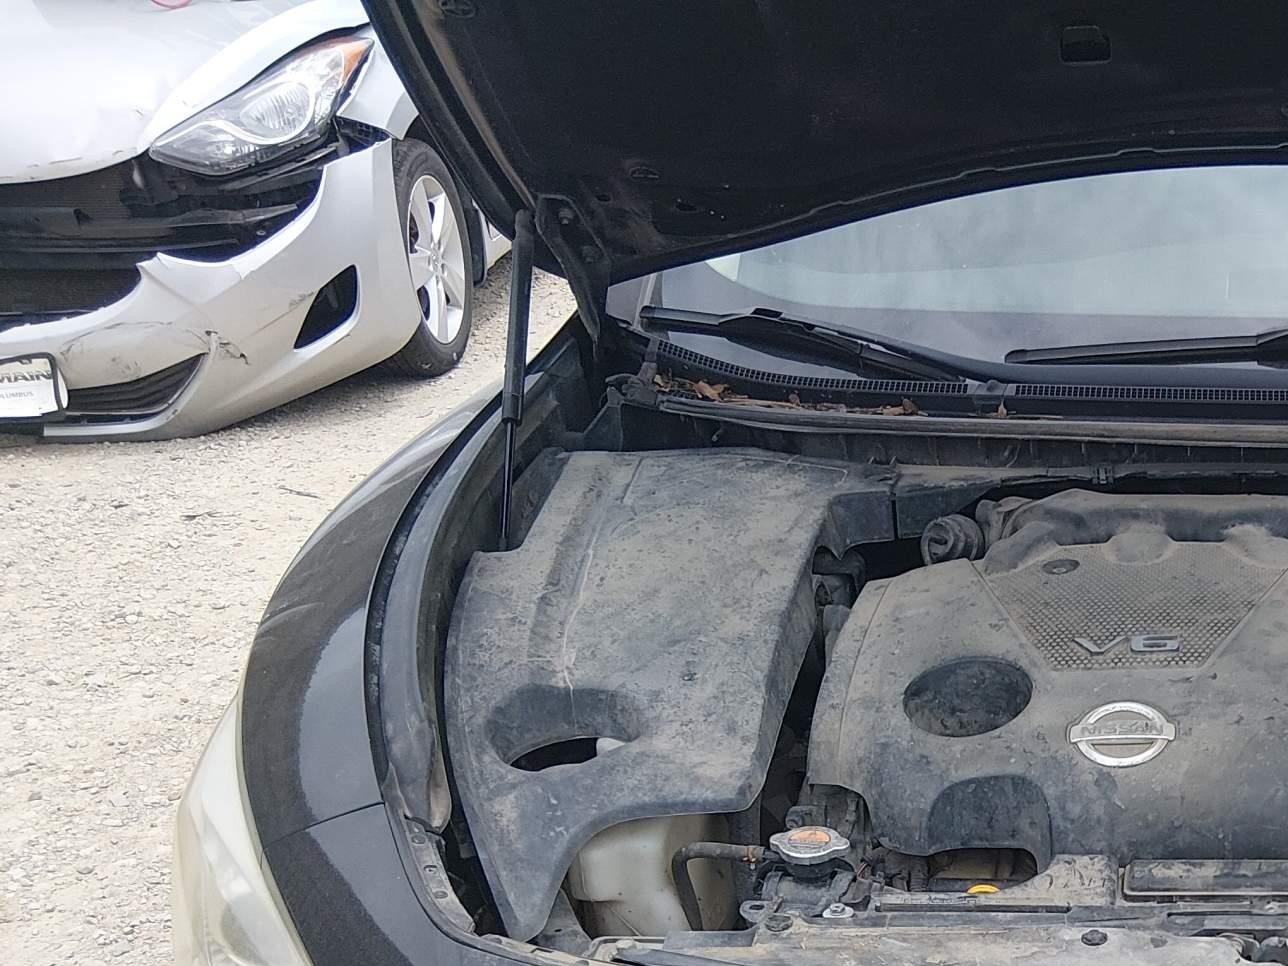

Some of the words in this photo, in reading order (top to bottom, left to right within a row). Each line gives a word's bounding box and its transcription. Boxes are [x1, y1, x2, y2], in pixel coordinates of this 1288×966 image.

[0, 391, 34, 399] LUMBUS
[1072, 634, 1180, 654] V6
[1080, 722, 1163, 735] NISSAN
